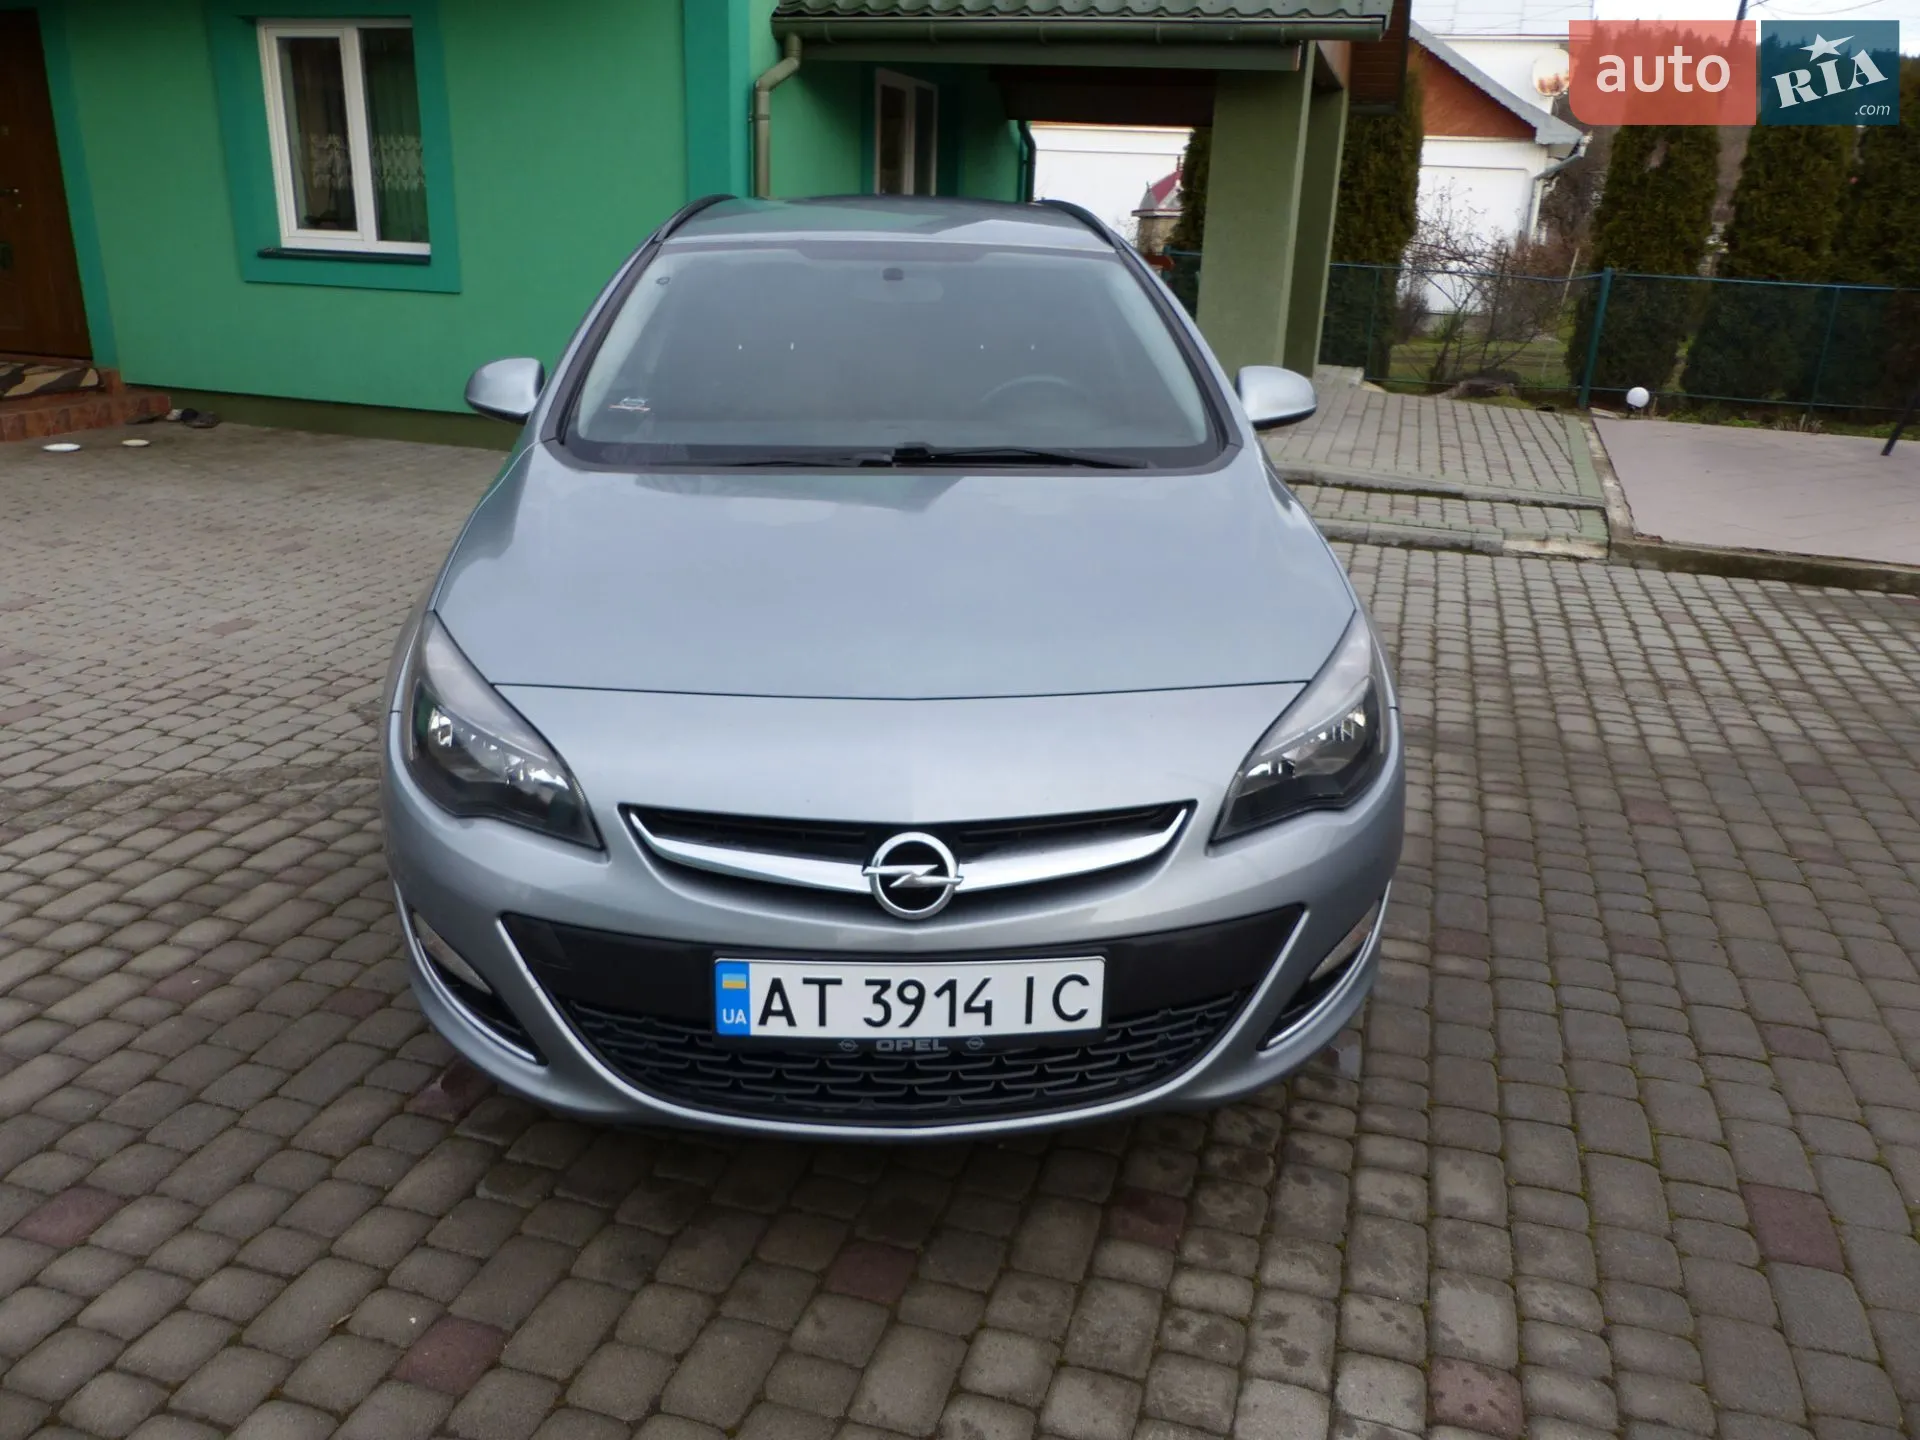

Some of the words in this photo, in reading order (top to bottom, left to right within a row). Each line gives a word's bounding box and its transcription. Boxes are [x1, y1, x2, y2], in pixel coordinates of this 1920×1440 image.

[758, 977, 843, 1027] AT
[863, 977, 993, 1028] 3914
[1024, 974, 1090, 1025] IC
[722, 1008, 747, 1025] UA
[876, 1039, 948, 1051] OPEL
